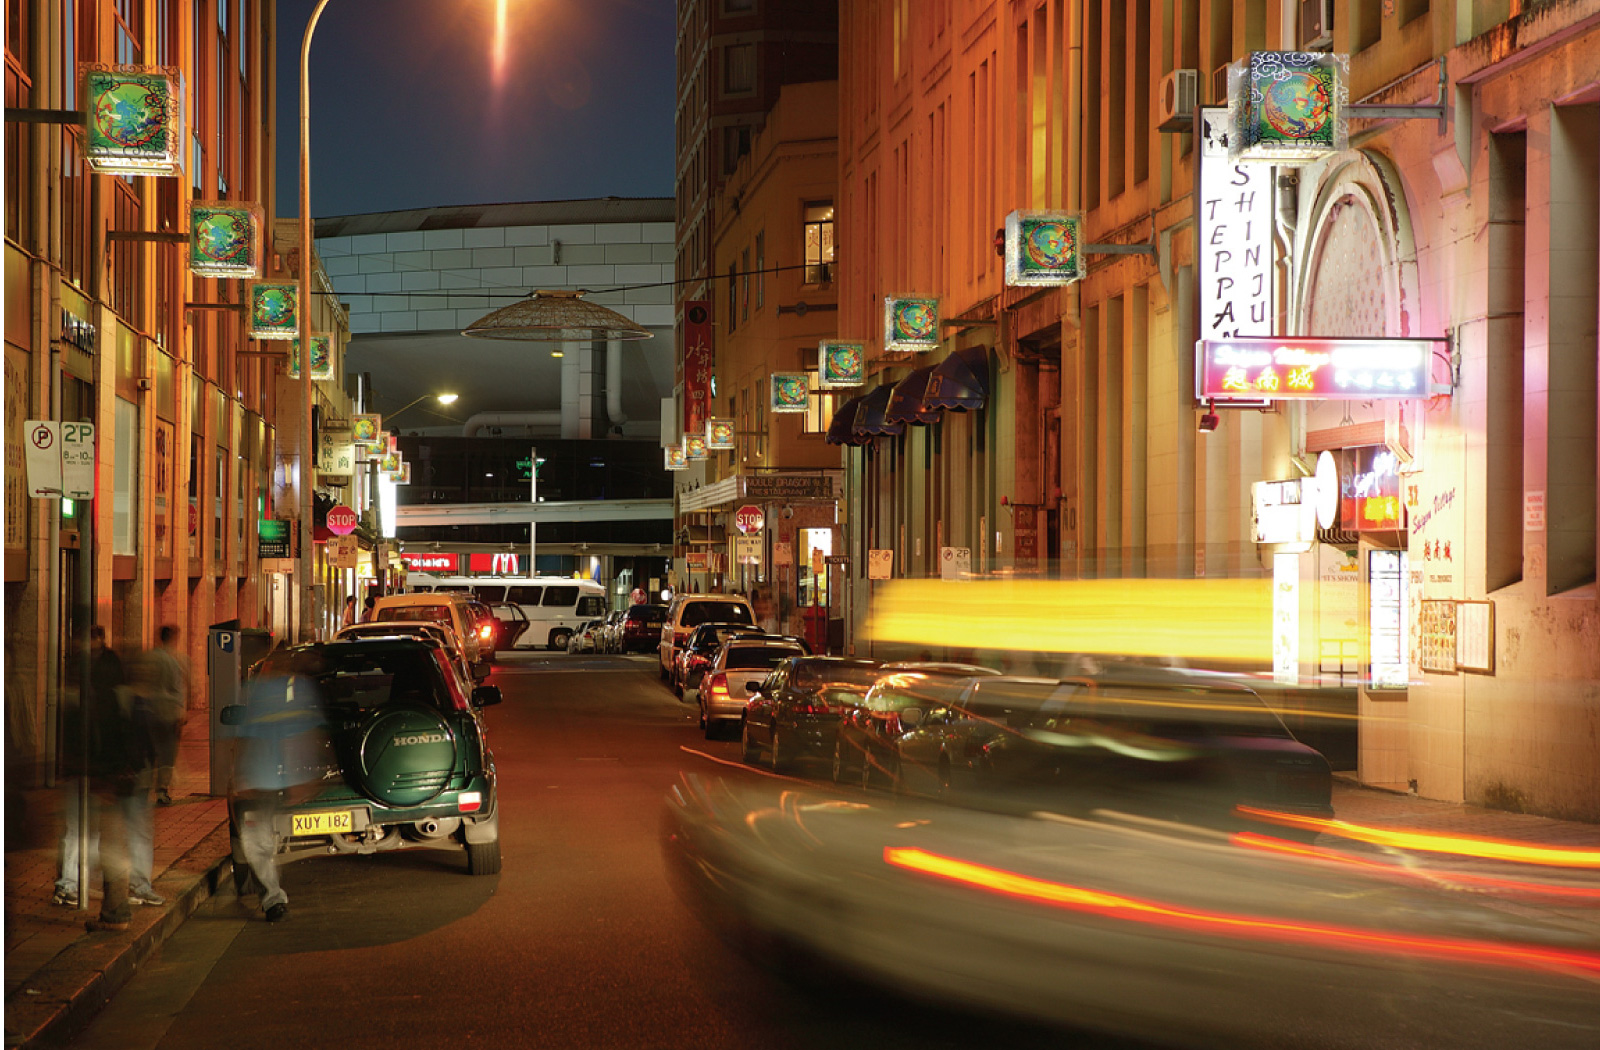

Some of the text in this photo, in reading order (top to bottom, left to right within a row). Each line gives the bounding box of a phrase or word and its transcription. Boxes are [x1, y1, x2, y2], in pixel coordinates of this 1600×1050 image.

[64, 424, 92, 443] 2P
[329, 514, 356, 526] STOP
[738, 514, 762, 524] STOP
[221, 633, 231, 649] P
[393, 734, 454, 746] HONDA
[295, 814, 349, 830] XUY 182
